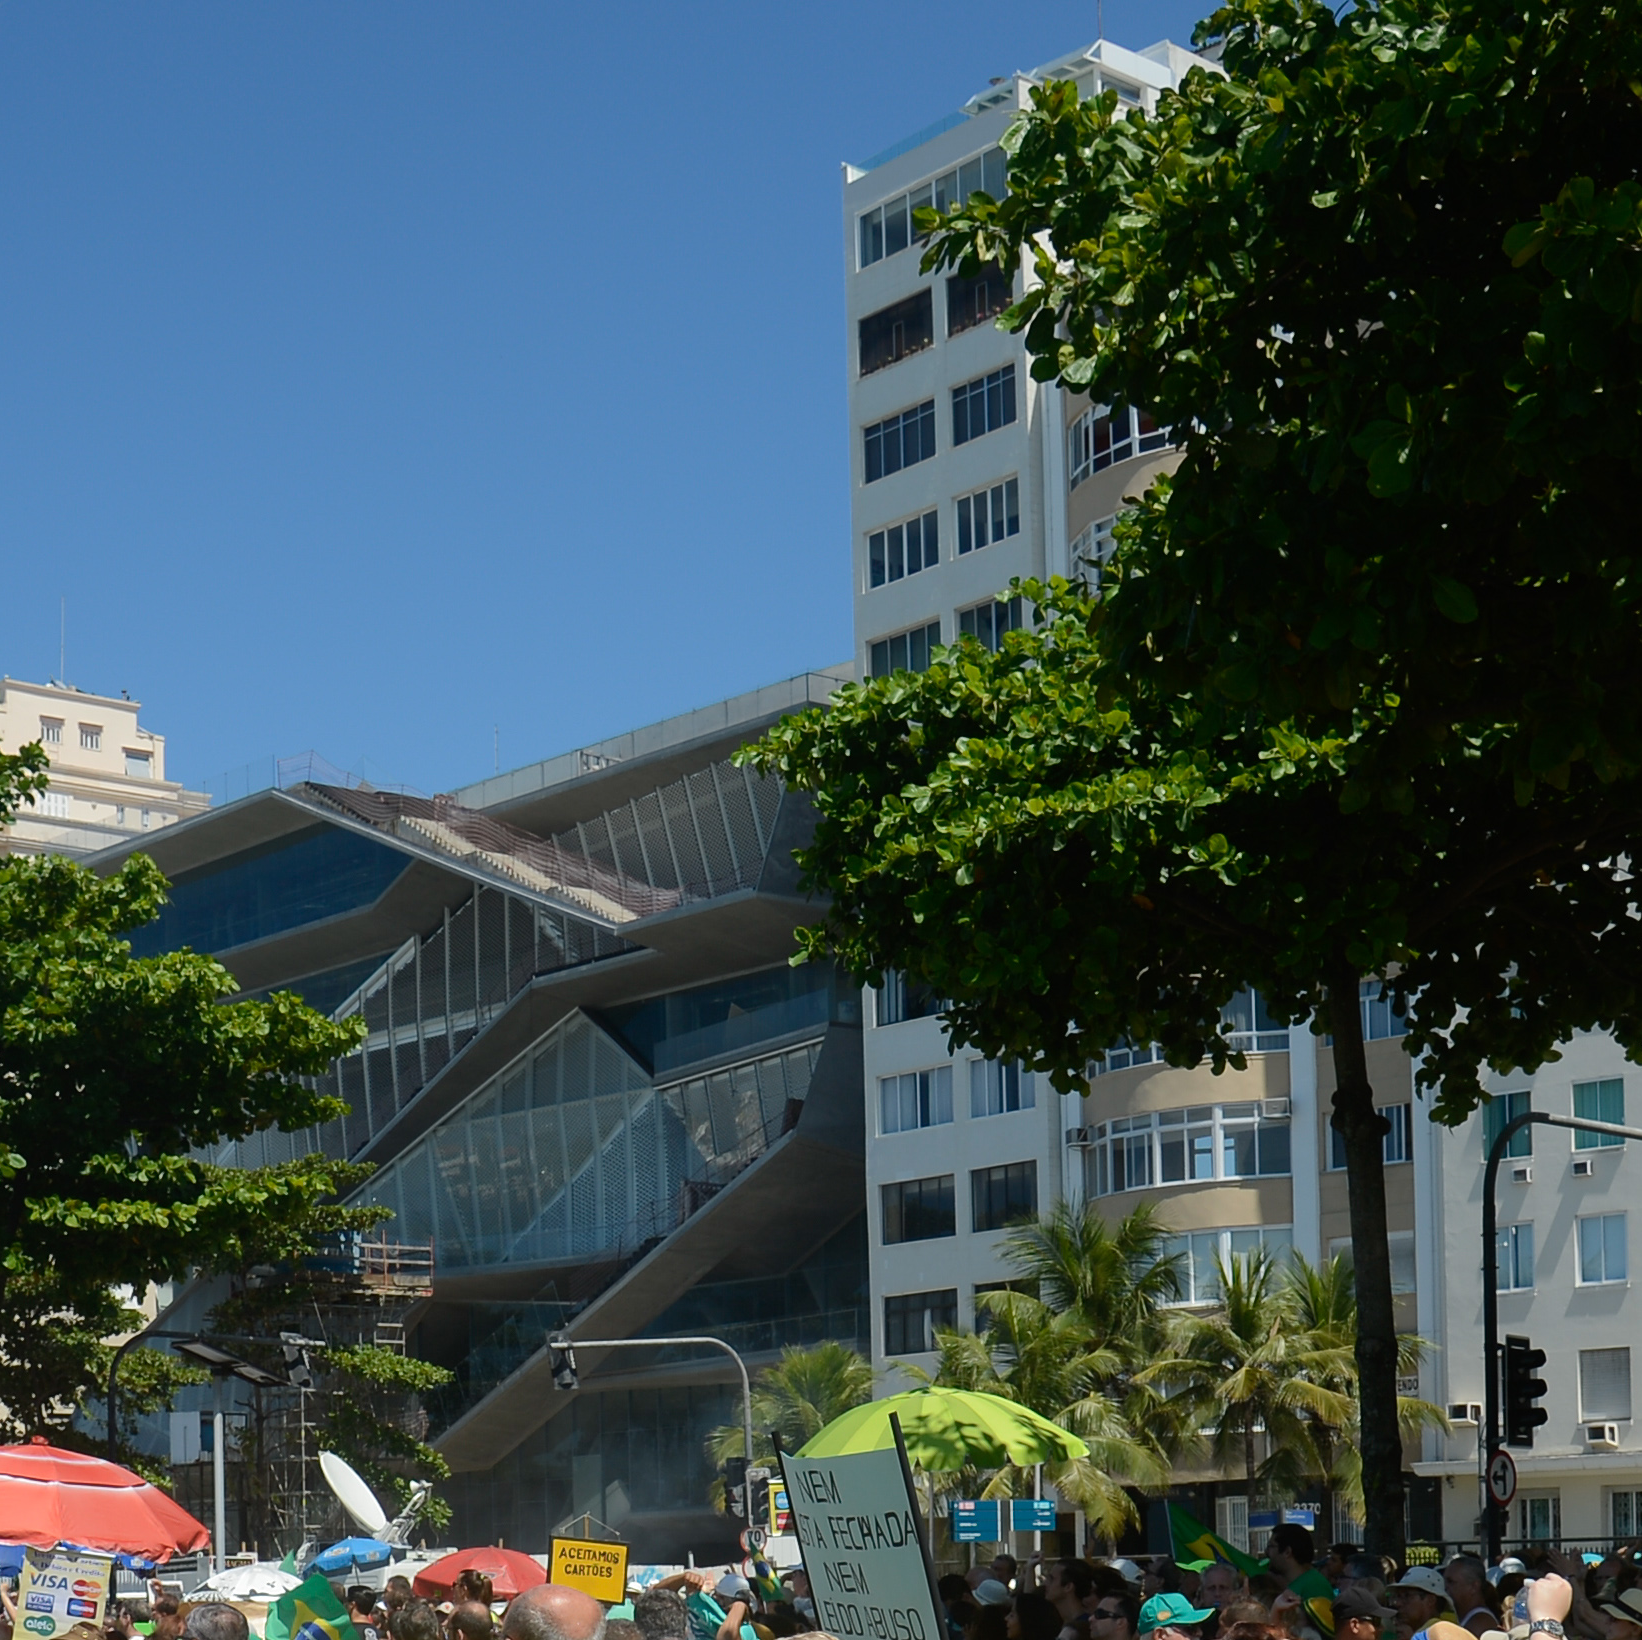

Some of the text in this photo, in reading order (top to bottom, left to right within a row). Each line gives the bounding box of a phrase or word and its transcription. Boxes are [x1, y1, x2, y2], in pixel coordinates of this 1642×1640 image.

[795, 1470, 842, 1504] NEM
[559, 1547, 620, 1564] ACEITAMOS
[564, 1563, 613, 1578] CARTÕES
[823, 1562, 870, 1595] NEM
[30, 1572, 68, 1590] VISA
[30, 1594, 53, 1604] VISA
